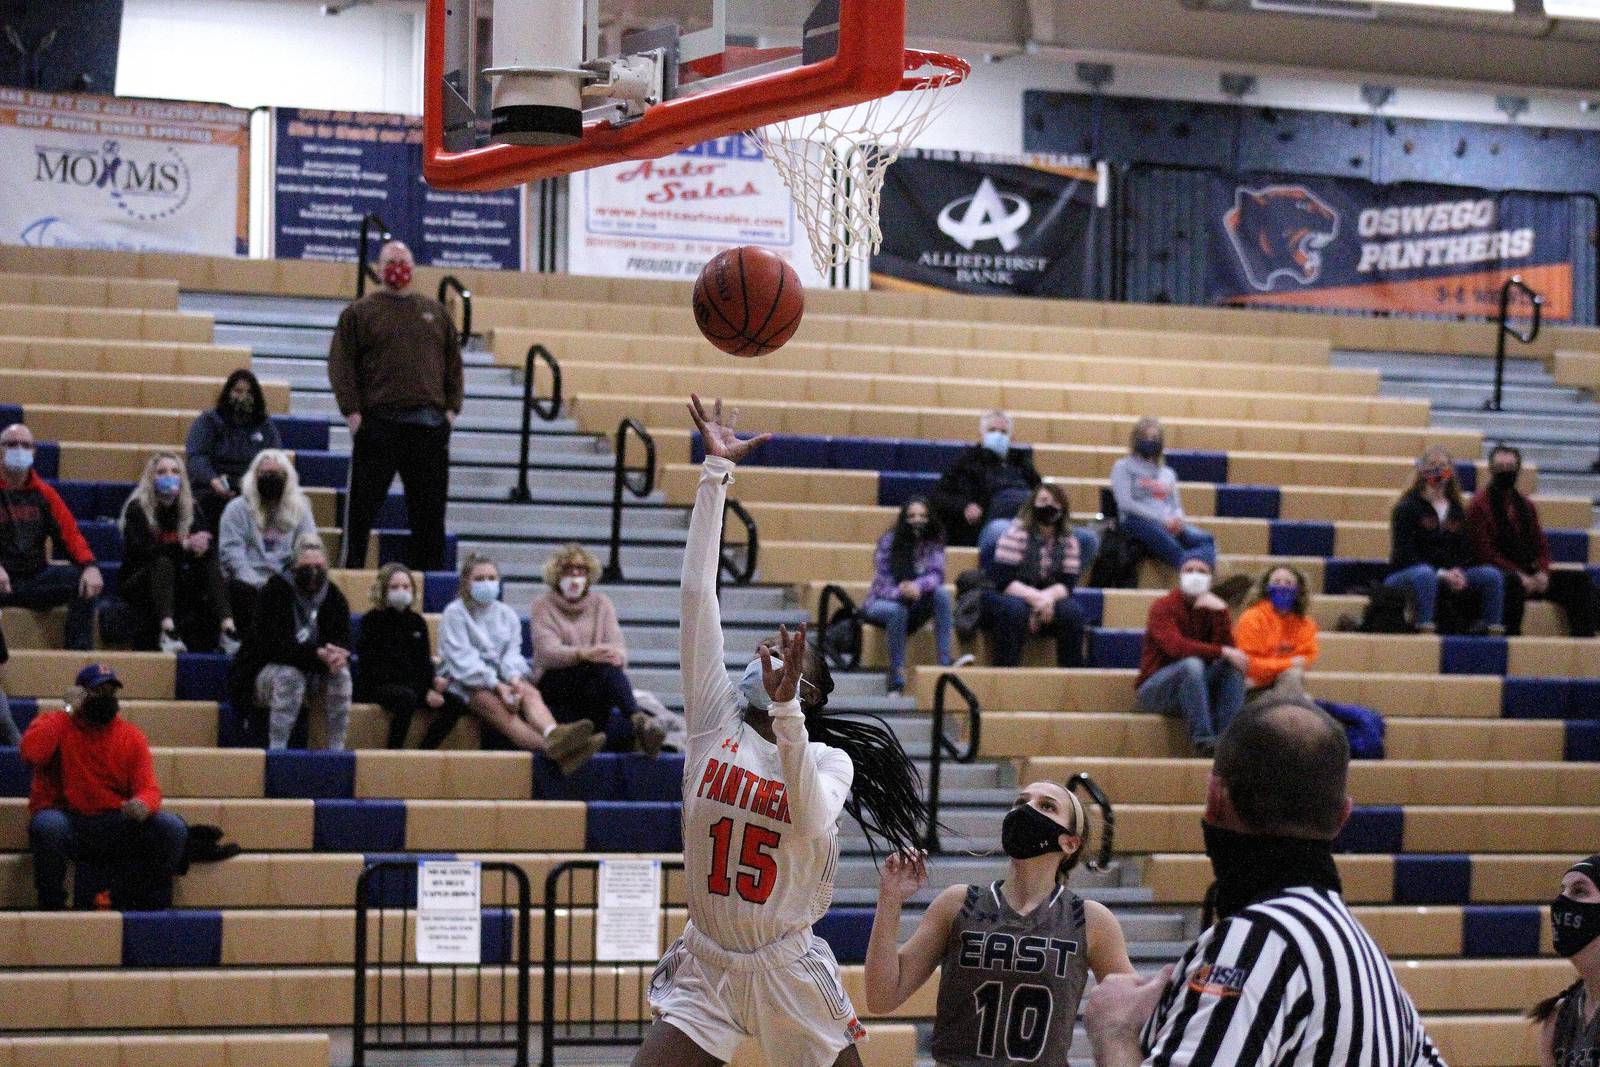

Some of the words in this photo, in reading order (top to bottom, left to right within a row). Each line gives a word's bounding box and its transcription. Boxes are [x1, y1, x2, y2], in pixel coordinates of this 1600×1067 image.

[616, 160, 726, 184] Auto
[645, 180, 761, 204] Sales
[1358, 200, 1496, 237] OSWEGO
[918, 251, 994, 270] ALLIED
[994, 255, 1049, 273] FIRST
[1356, 228, 1536, 273] PANTHERS
[956, 269, 1014, 285] BANK
[707, 816, 781, 905] 15
[958, 930, 1078, 979] EAST
[973, 980, 1054, 1063] 10
